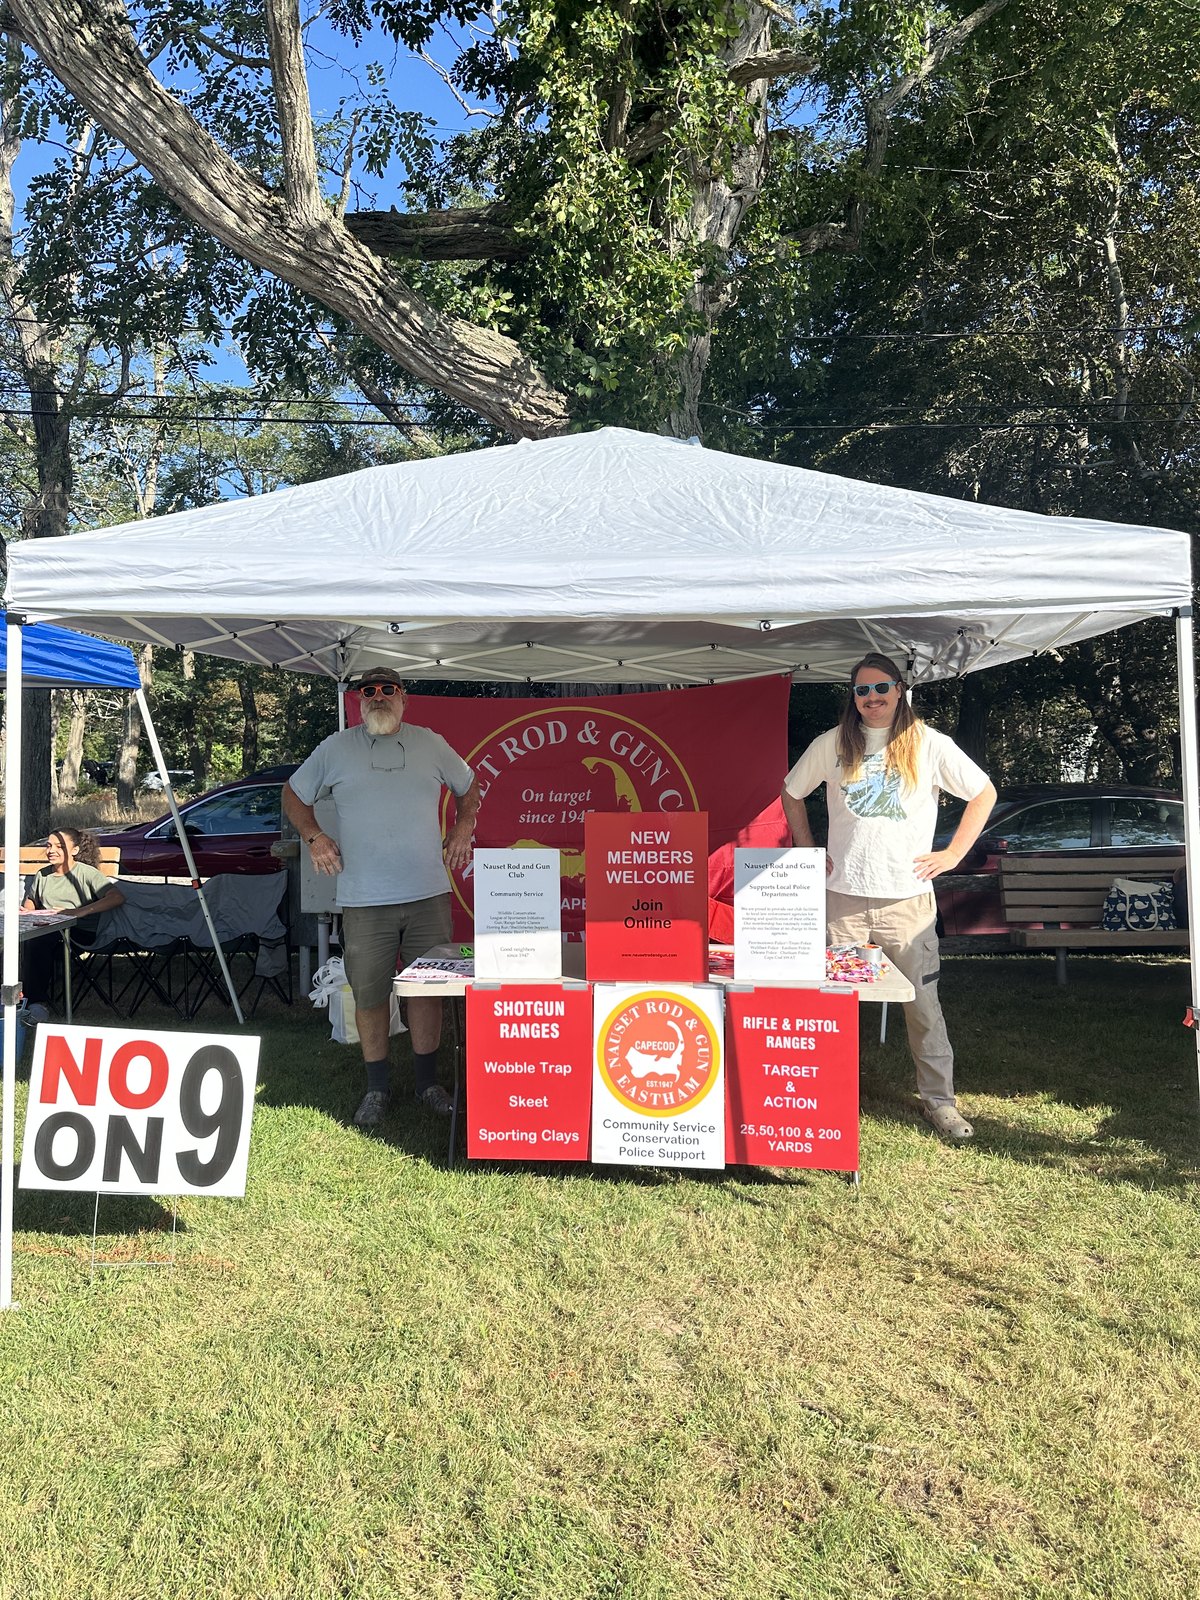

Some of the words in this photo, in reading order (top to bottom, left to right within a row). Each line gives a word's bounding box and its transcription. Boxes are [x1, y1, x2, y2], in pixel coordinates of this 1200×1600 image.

[498, 720, 568, 764] ROD
[577, 720, 600, 746] &
[609, 730, 670, 786] GUN
[522, 788, 546, 802] On
[548, 788, 592, 806] target
[519, 810, 556, 824] since
[559, 810, 595, 824] 194
[630, 830, 670, 844] NEW
[608, 850, 694, 864] MEMBERS
[606, 870, 694, 884] WELCOME
[632, 899, 663, 911] Join
[624, 916, 672, 929] Online
[494, 1000, 565, 1016] SHOTGUN
[500, 1023, 560, 1038] RANGES
[743, 1016, 778, 1030] RIFLE
[782, 1018, 791, 1030] &
[796, 1019, 839, 1032] PISTOL
[608, 1005, 640, 1069] NAUSET
[646, 1001, 683, 1018] ROD
[684, 1018, 698, 1032] &
[695, 1034, 710, 1072] GUN
[766, 1036, 816, 1050] RANGES
[635, 1040, 676, 1051] CAPECOD
[40, 1035, 170, 1110] NO
[484, 1061, 536, 1074] Wobble
[540, 1062, 572, 1076] Trap
[762, 1064, 819, 1078] TARGET
[616, 1075, 701, 1106] EASTHAM
[786, 1081, 796, 1092] &
[509, 1096, 548, 1107] Skeet
[763, 1096, 817, 1110] ACTION
[176, 1044, 244, 1187] 9
[602, 1119, 669, 1133] Community
[672, 1122, 716, 1133] Service
[740, 1124, 801, 1138] 25,50,100
[805, 1128, 814, 1138] &
[818, 1129, 841, 1140] 200
[479, 1128, 537, 1143] Sporting
[542, 1129, 579, 1144] Clays
[622, 1133, 700, 1145] Conservation
[34, 1111, 164, 1184] ON
[619, 1146, 654, 1158] Police
[658, 1148, 706, 1160] Support
[768, 1140, 812, 1153] YARDS
